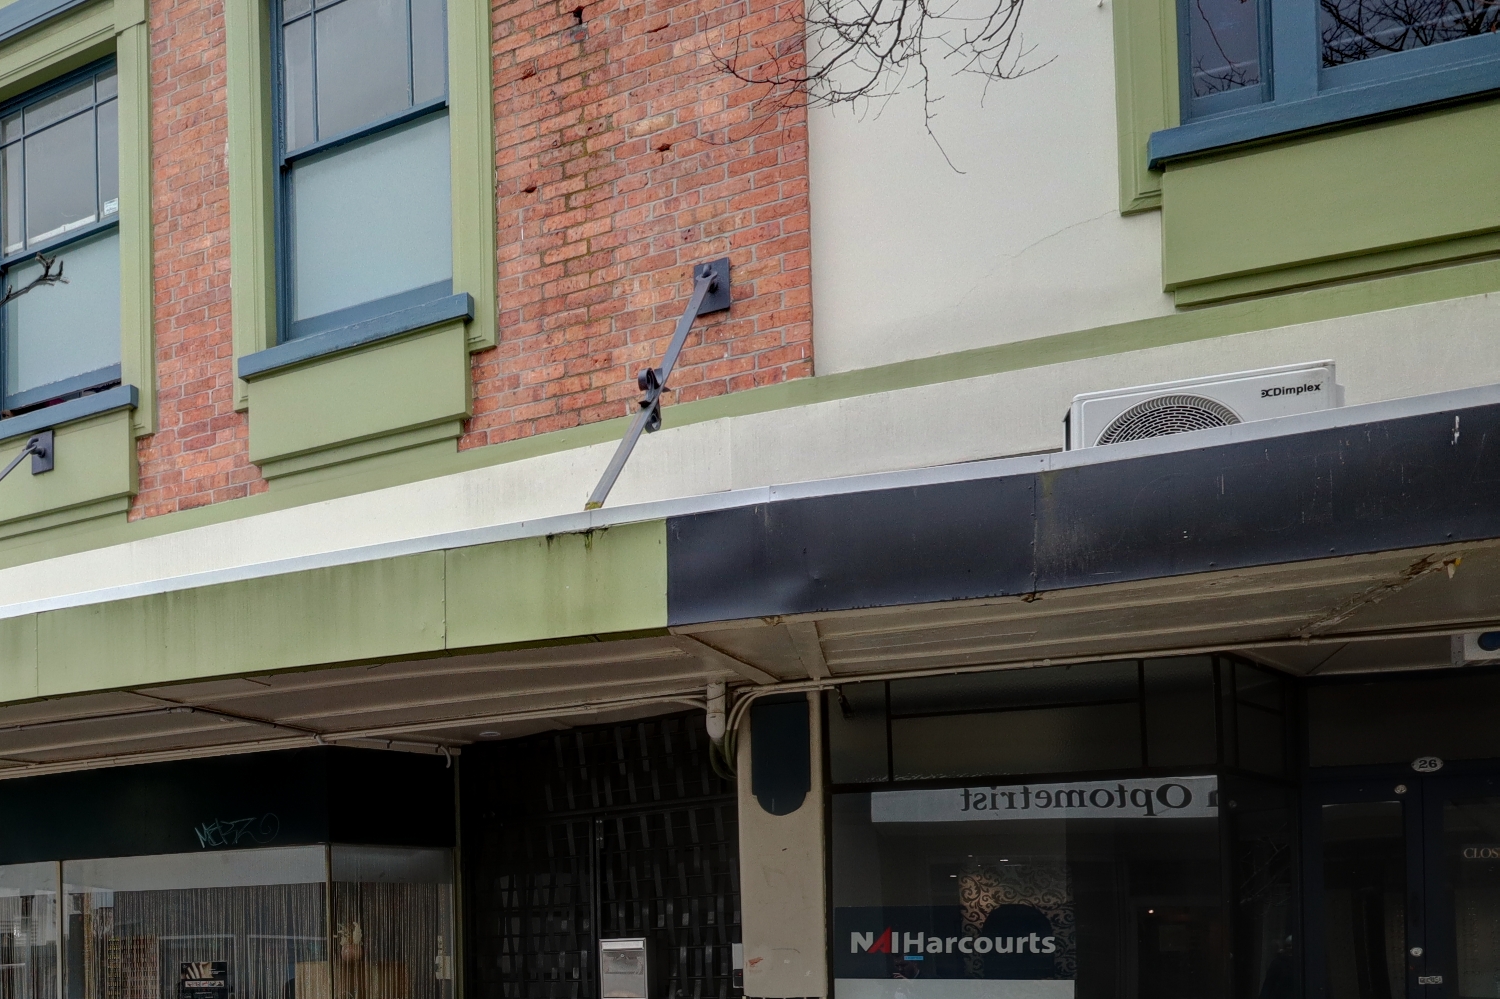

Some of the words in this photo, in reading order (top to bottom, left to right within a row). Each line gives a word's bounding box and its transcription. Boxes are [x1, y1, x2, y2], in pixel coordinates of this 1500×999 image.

[1273, 383, 1321, 396] Dimplex
[1418, 759, 1438, 769] 26
[851, 926, 899, 953] NAI
[904, 932, 1057, 954] Harcourts
